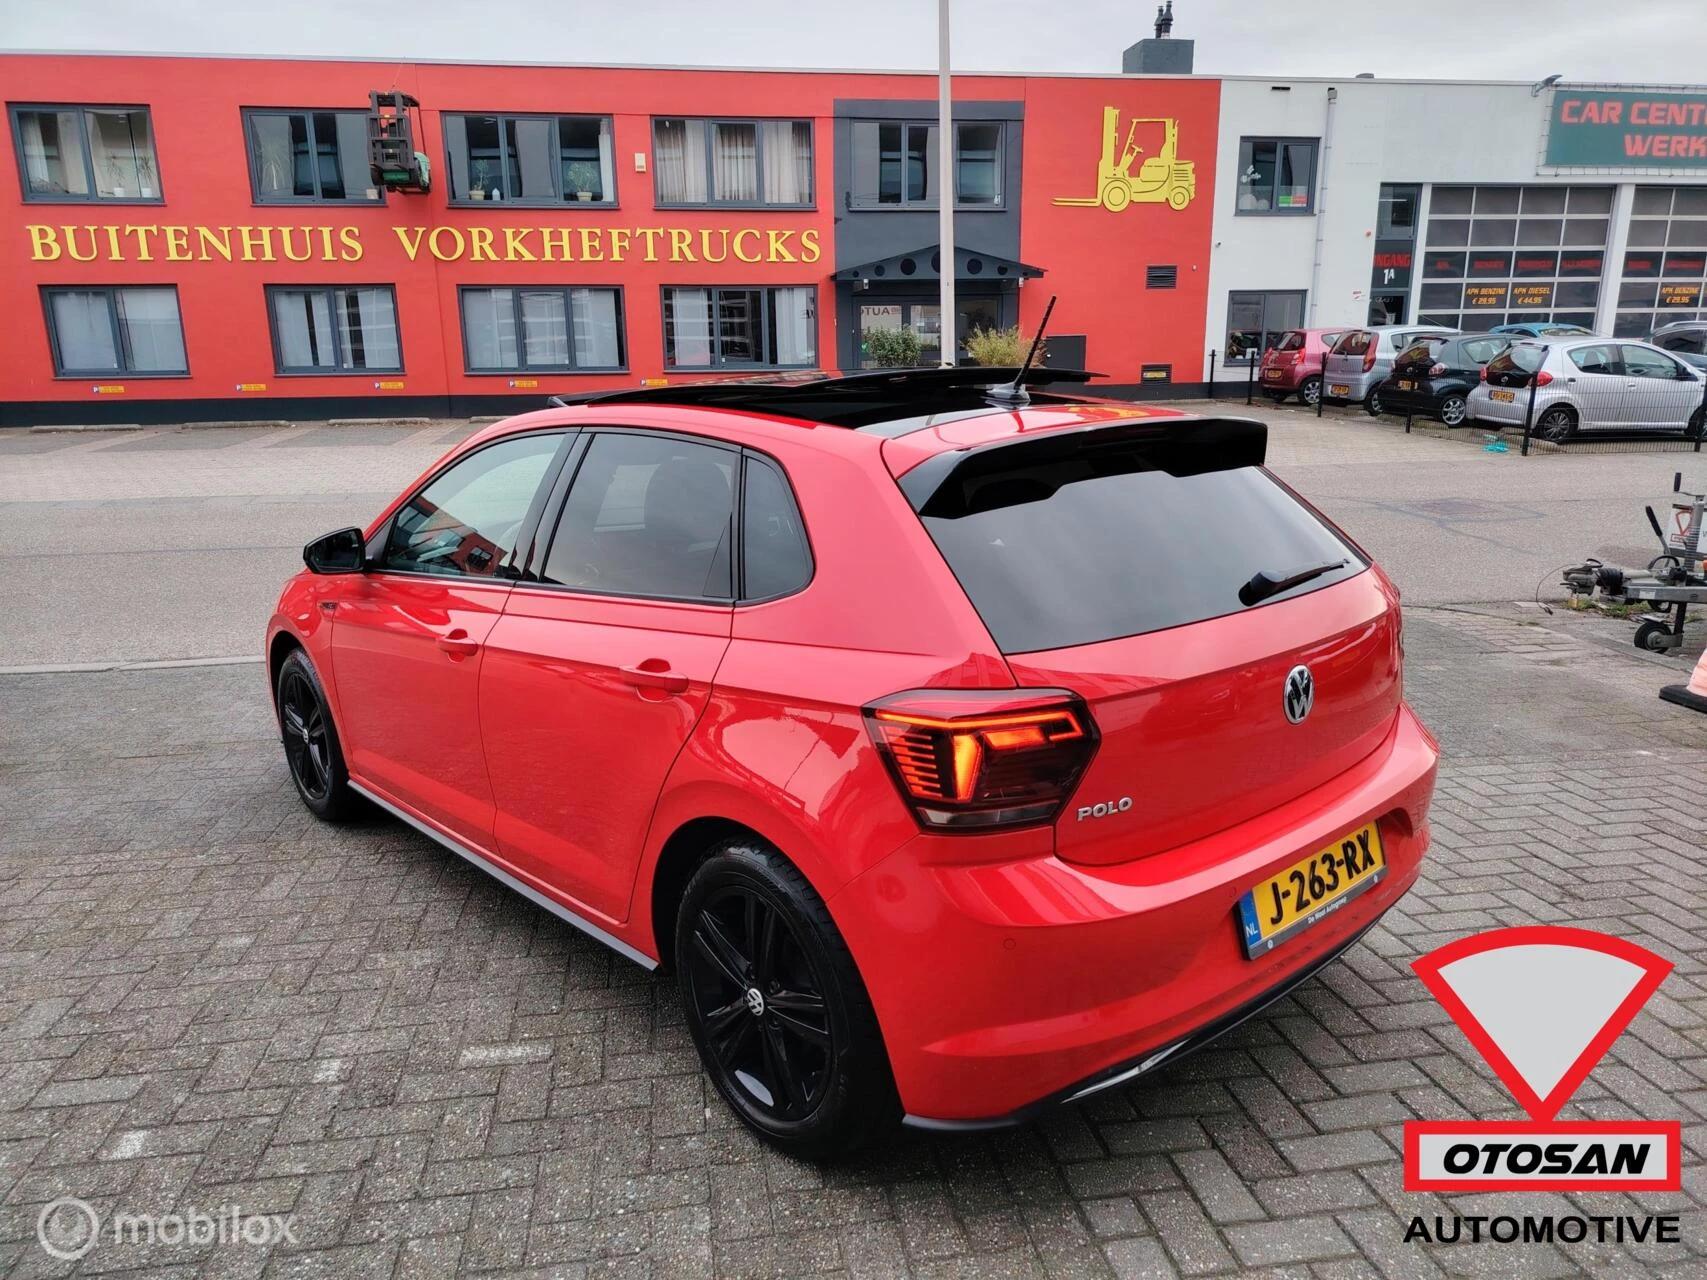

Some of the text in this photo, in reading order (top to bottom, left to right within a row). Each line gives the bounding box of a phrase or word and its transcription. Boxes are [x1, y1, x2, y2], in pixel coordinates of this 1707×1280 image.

[1560, 100, 1707, 126] CAR CENT
[26, 225, 821, 263] BUITENHUIS VORKHEFTRUCKS
[1078, 797, 1133, 821] POLO
[1270, 829, 1375, 925] J-263-RX
[1245, 922, 1258, 938] NL
